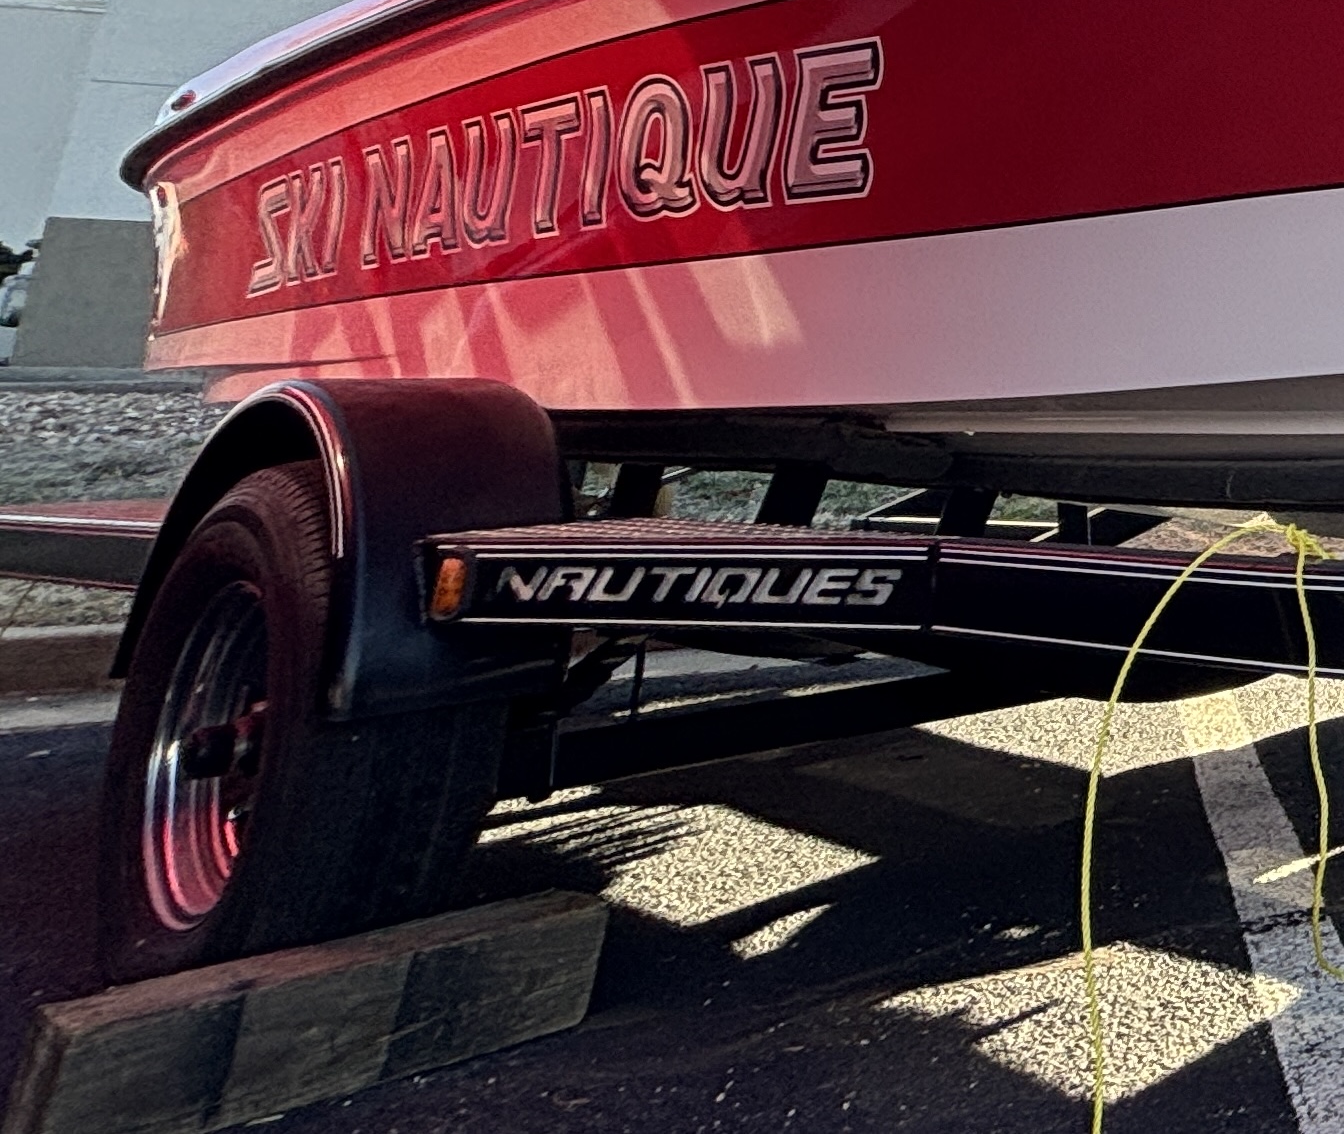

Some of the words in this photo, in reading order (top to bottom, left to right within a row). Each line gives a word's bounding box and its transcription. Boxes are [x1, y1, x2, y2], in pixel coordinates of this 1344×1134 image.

[246, 158, 346, 300] SKI
[360, 36, 885, 272] NAUTIQUE
[495, 566, 902, 609] NAUTIQUES
